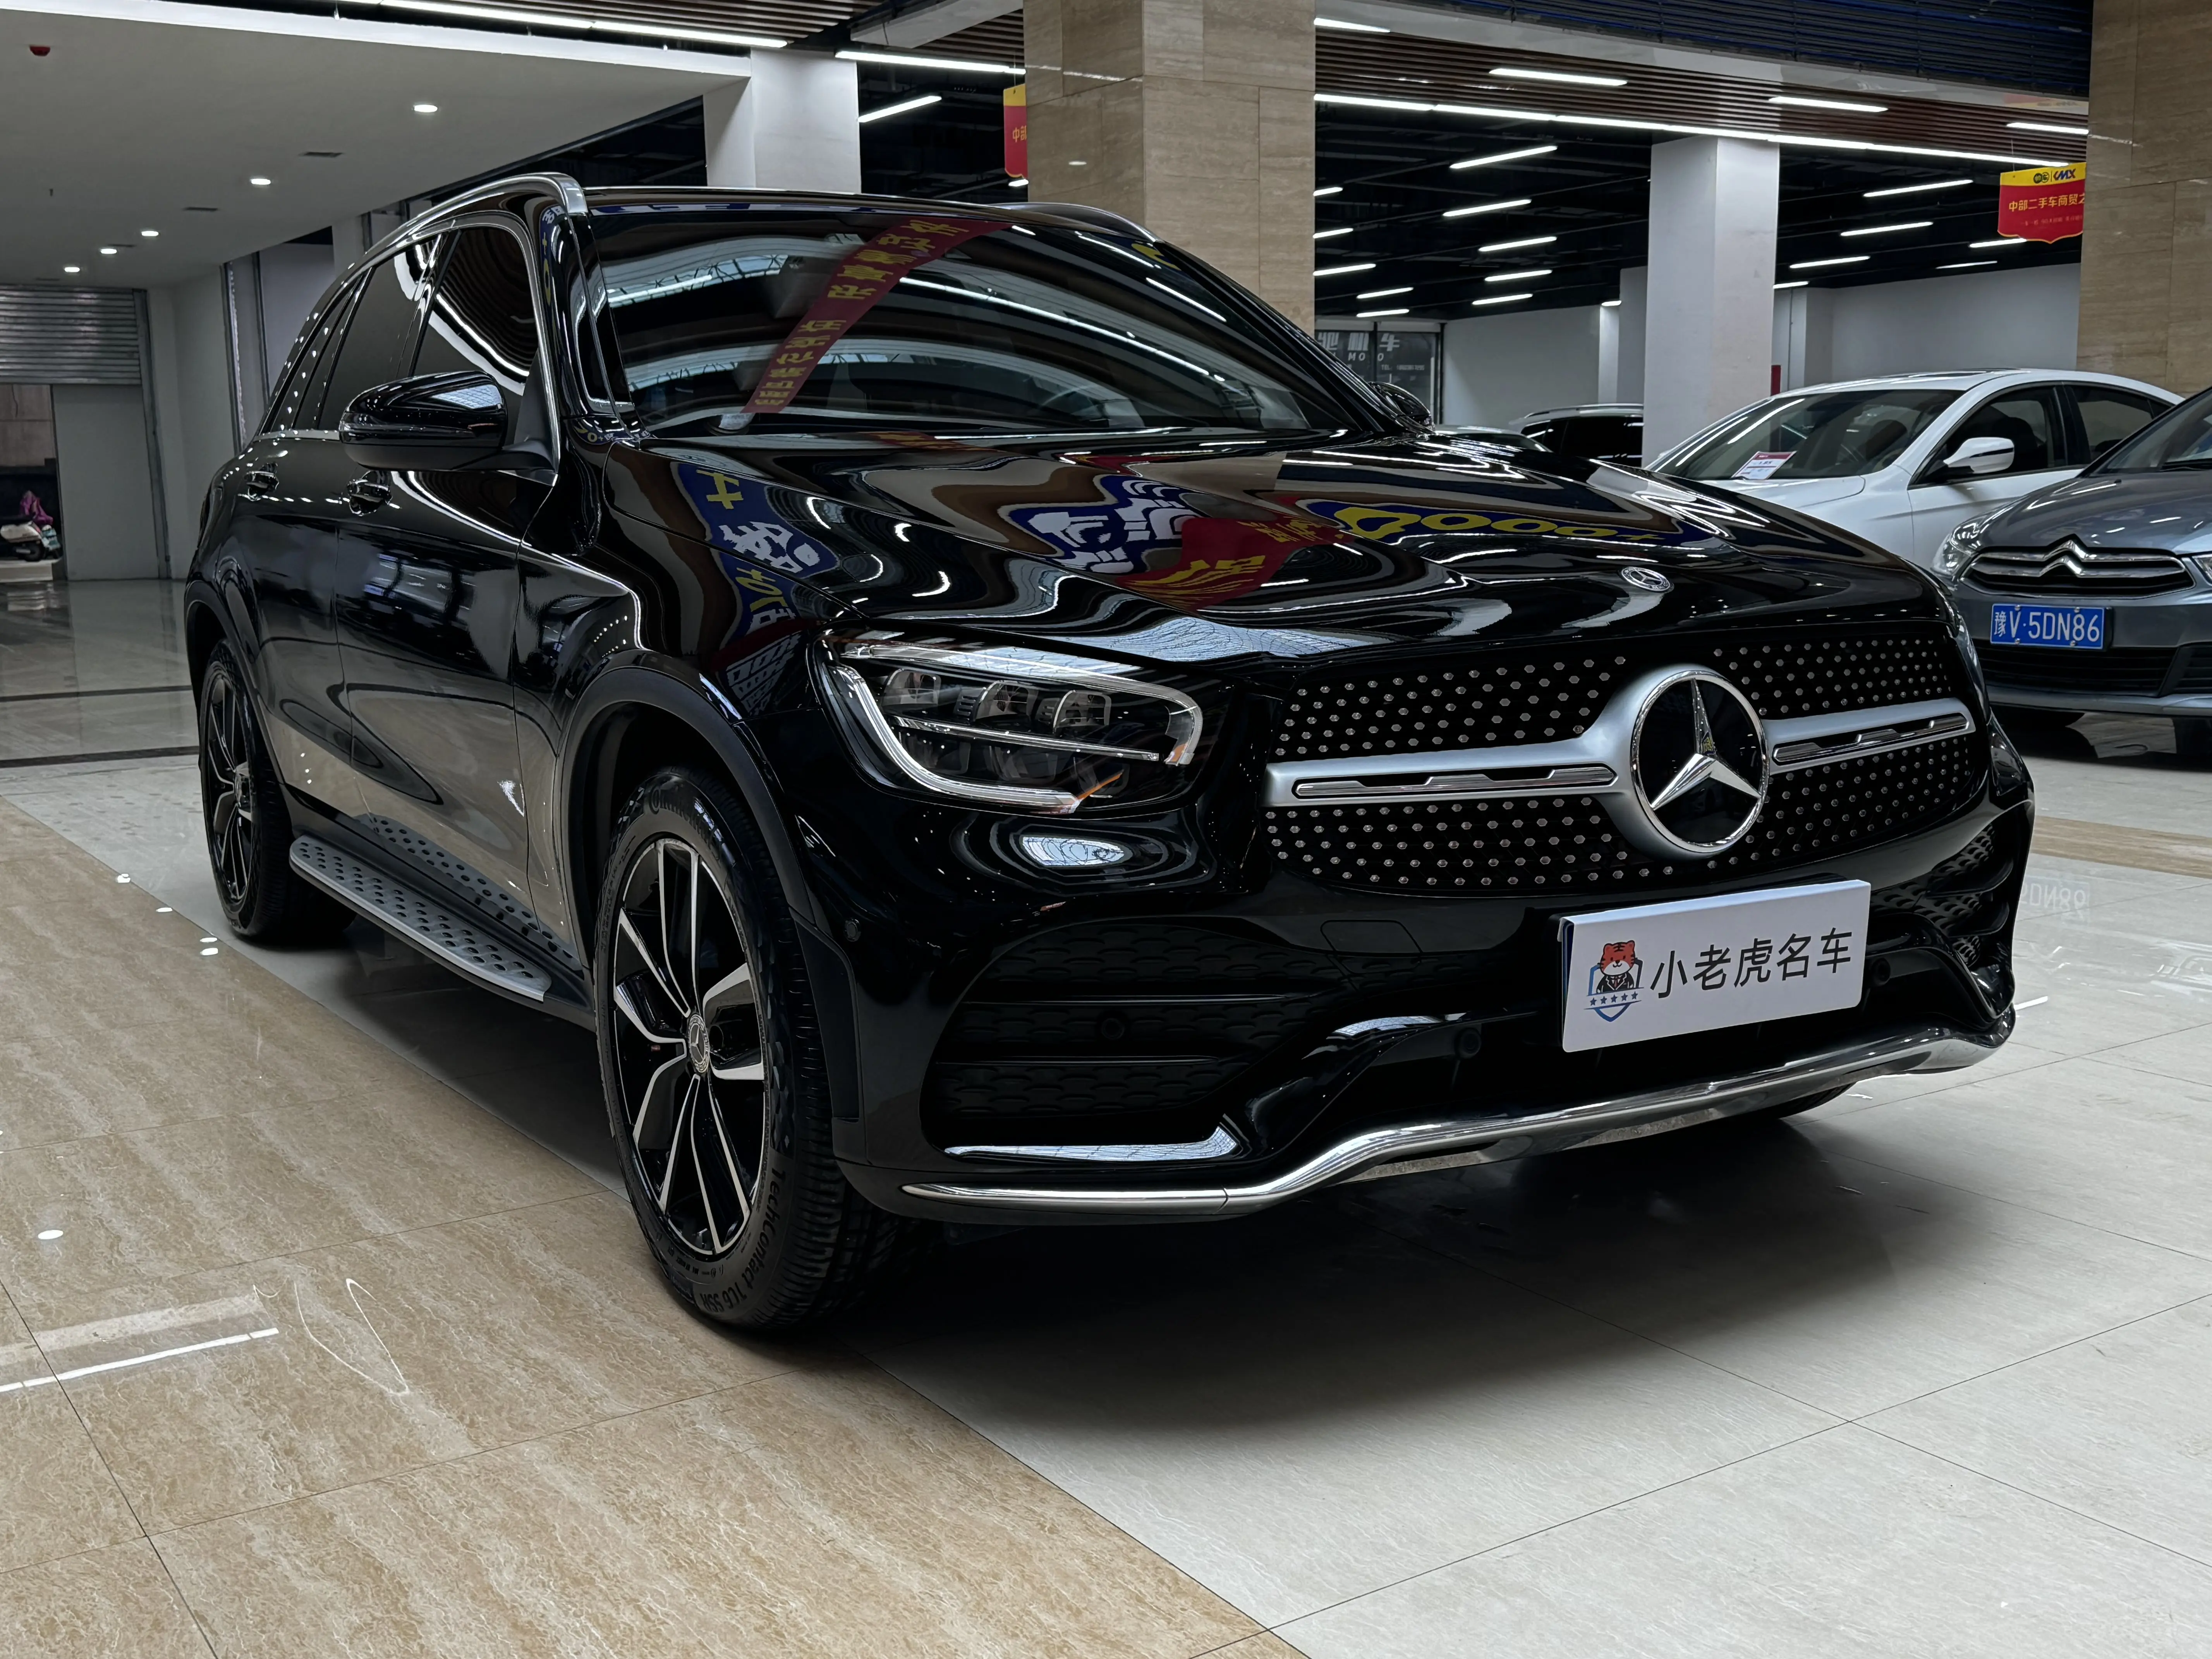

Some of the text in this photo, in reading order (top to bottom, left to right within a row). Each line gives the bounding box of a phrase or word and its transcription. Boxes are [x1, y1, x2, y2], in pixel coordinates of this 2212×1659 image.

[1650, 927, 1853, 998] 小老虎名车
